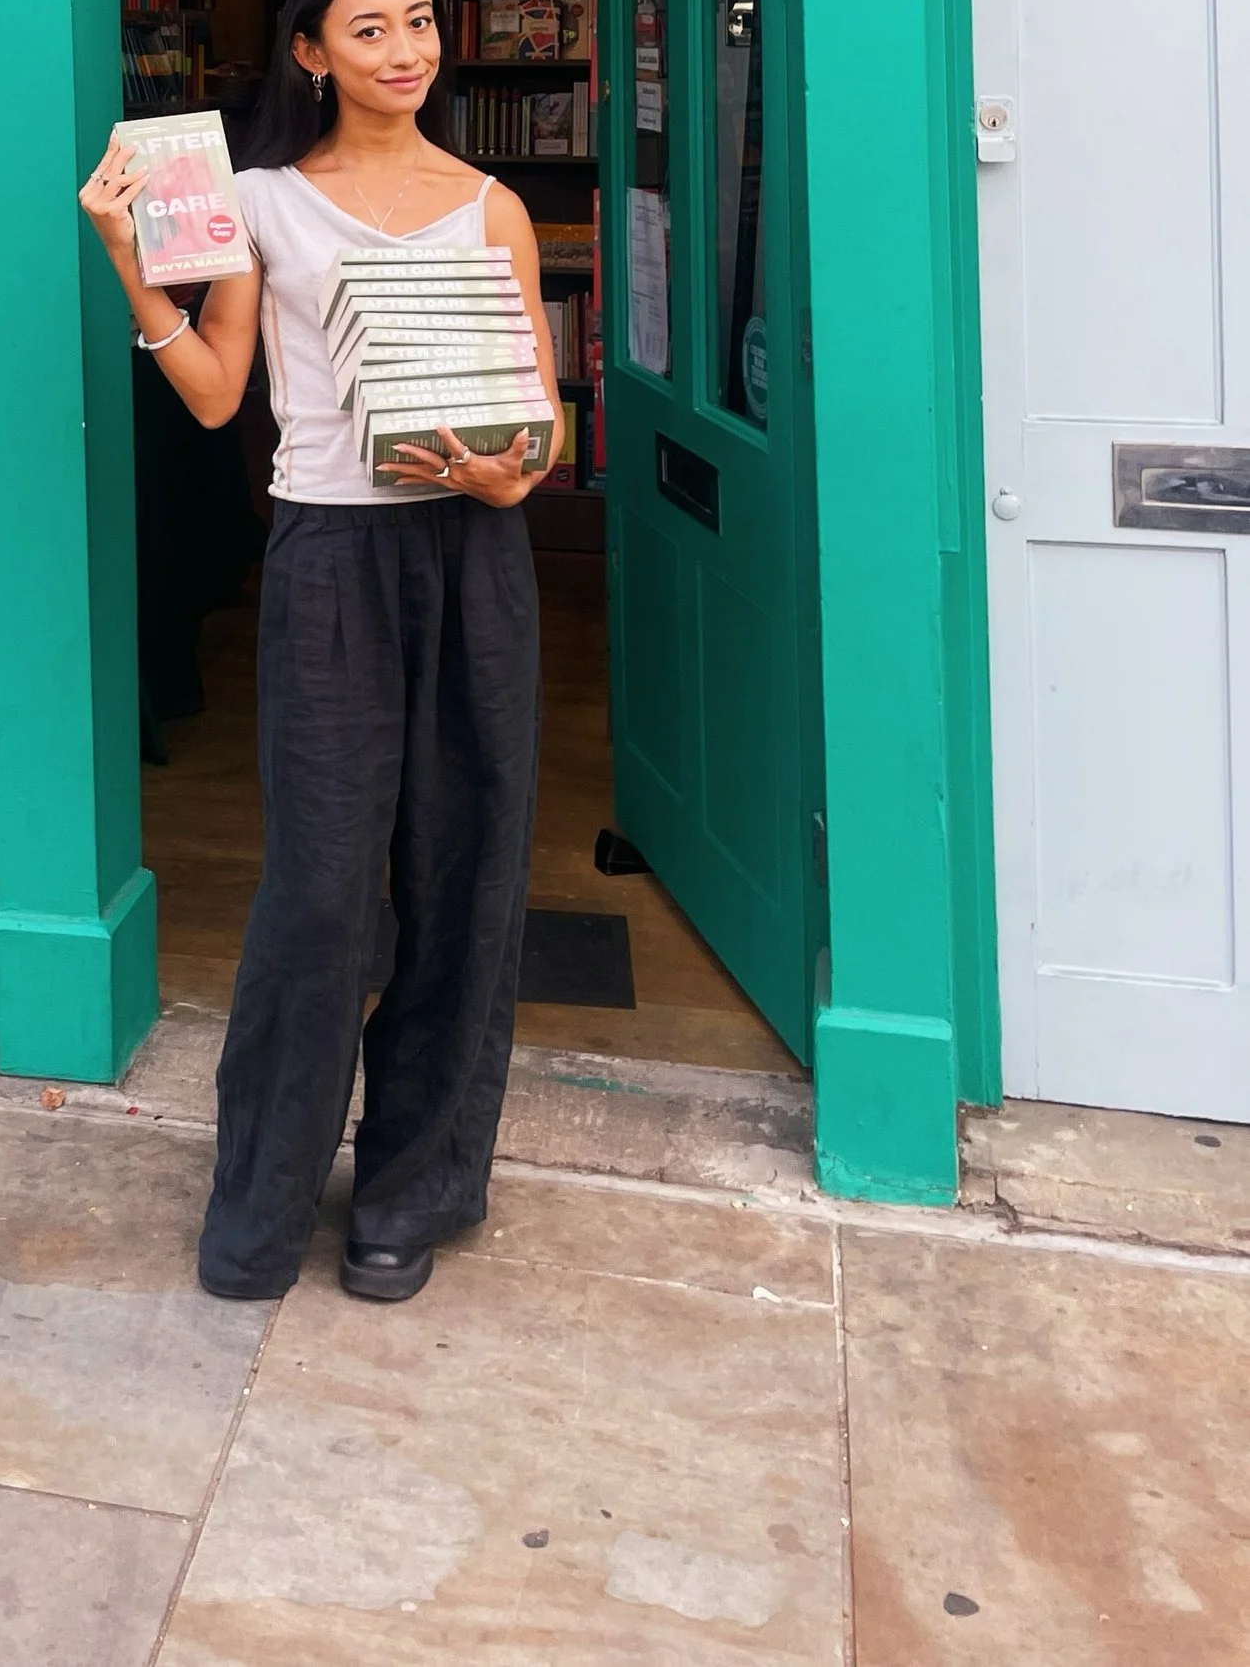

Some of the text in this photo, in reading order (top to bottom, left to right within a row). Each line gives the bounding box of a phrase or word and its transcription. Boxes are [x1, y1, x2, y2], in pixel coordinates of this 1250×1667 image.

[133, 130, 224, 155] AFTER
[146, 192, 227, 218] CARE
[210, 221, 233, 230] Signed
[213, 229, 231, 238] Copy
[353, 248, 457, 259] AFTER CARE
[151, 260, 193, 274] DIVYA
[350, 264, 457, 277] AFTER CARE
[359, 280, 465, 293] AFTER CARE
[366, 297, 471, 309] AFTER CARE
[371, 314, 478, 327] AFTER CARE
[379, 330, 483, 343] AFTER CARE
[374, 345, 478, 359] AFTER CARE
[370, 359, 478, 377] AFTER CARE
[374, 376, 483, 394] AFTER CARE
[377, 391, 486, 407] AFTER CARE
[445, 412, 494, 425] CARE
